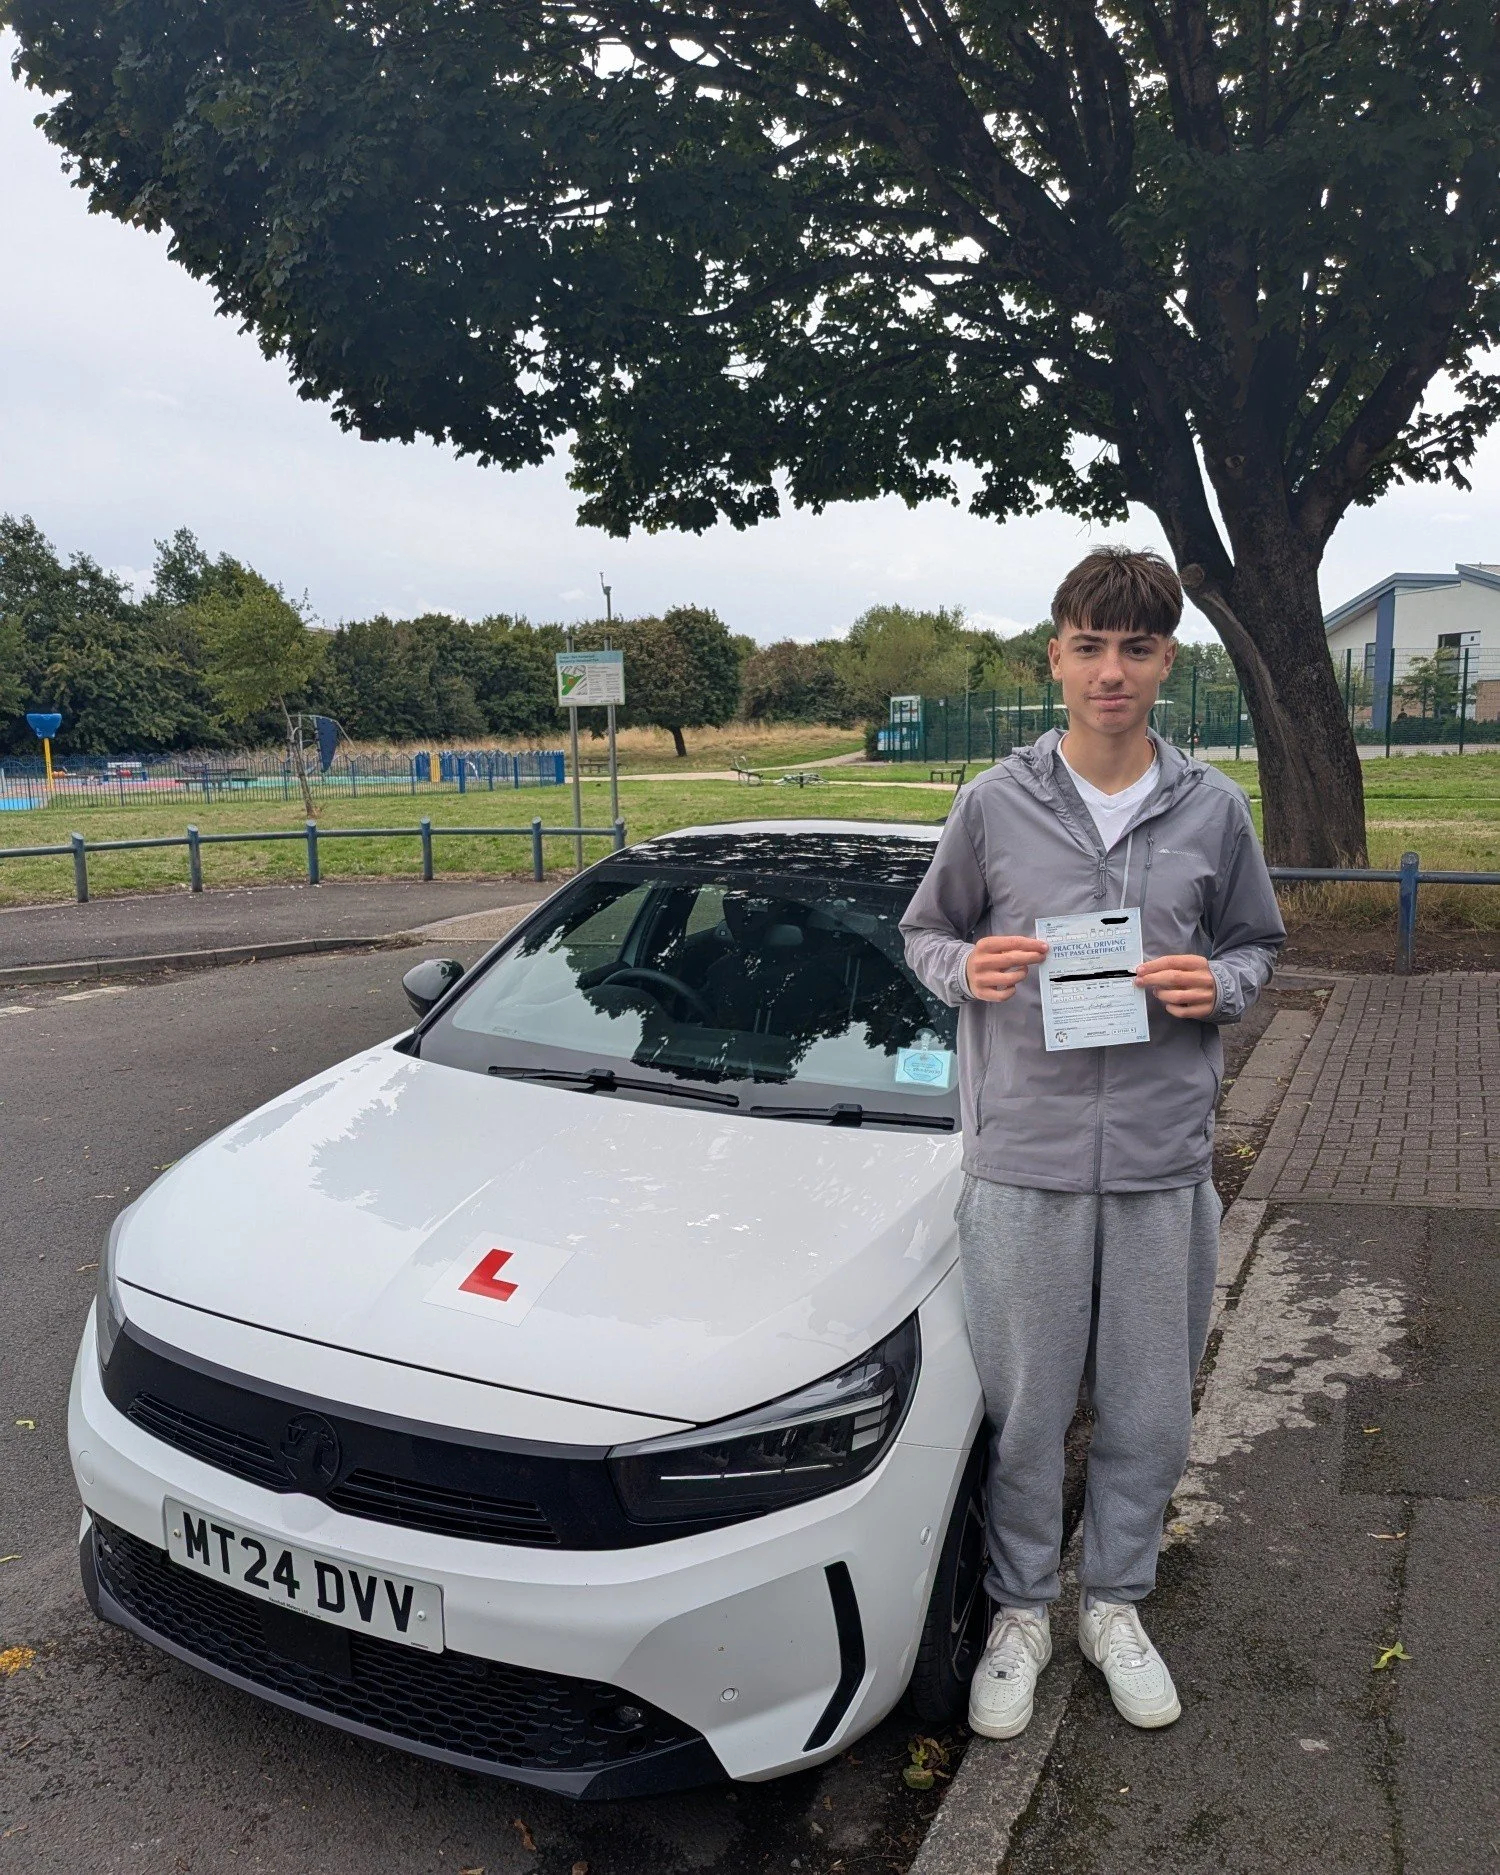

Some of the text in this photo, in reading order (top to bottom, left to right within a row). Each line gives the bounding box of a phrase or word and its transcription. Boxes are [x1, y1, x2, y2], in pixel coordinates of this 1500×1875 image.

[1053, 939, 1126, 952] PRACTICAL DRIVING
[1086, 945, 1126, 955] CERTIFICATE
[458, 1249, 519, 1302] L
[183, 1511, 414, 1633] MT24 DVV
